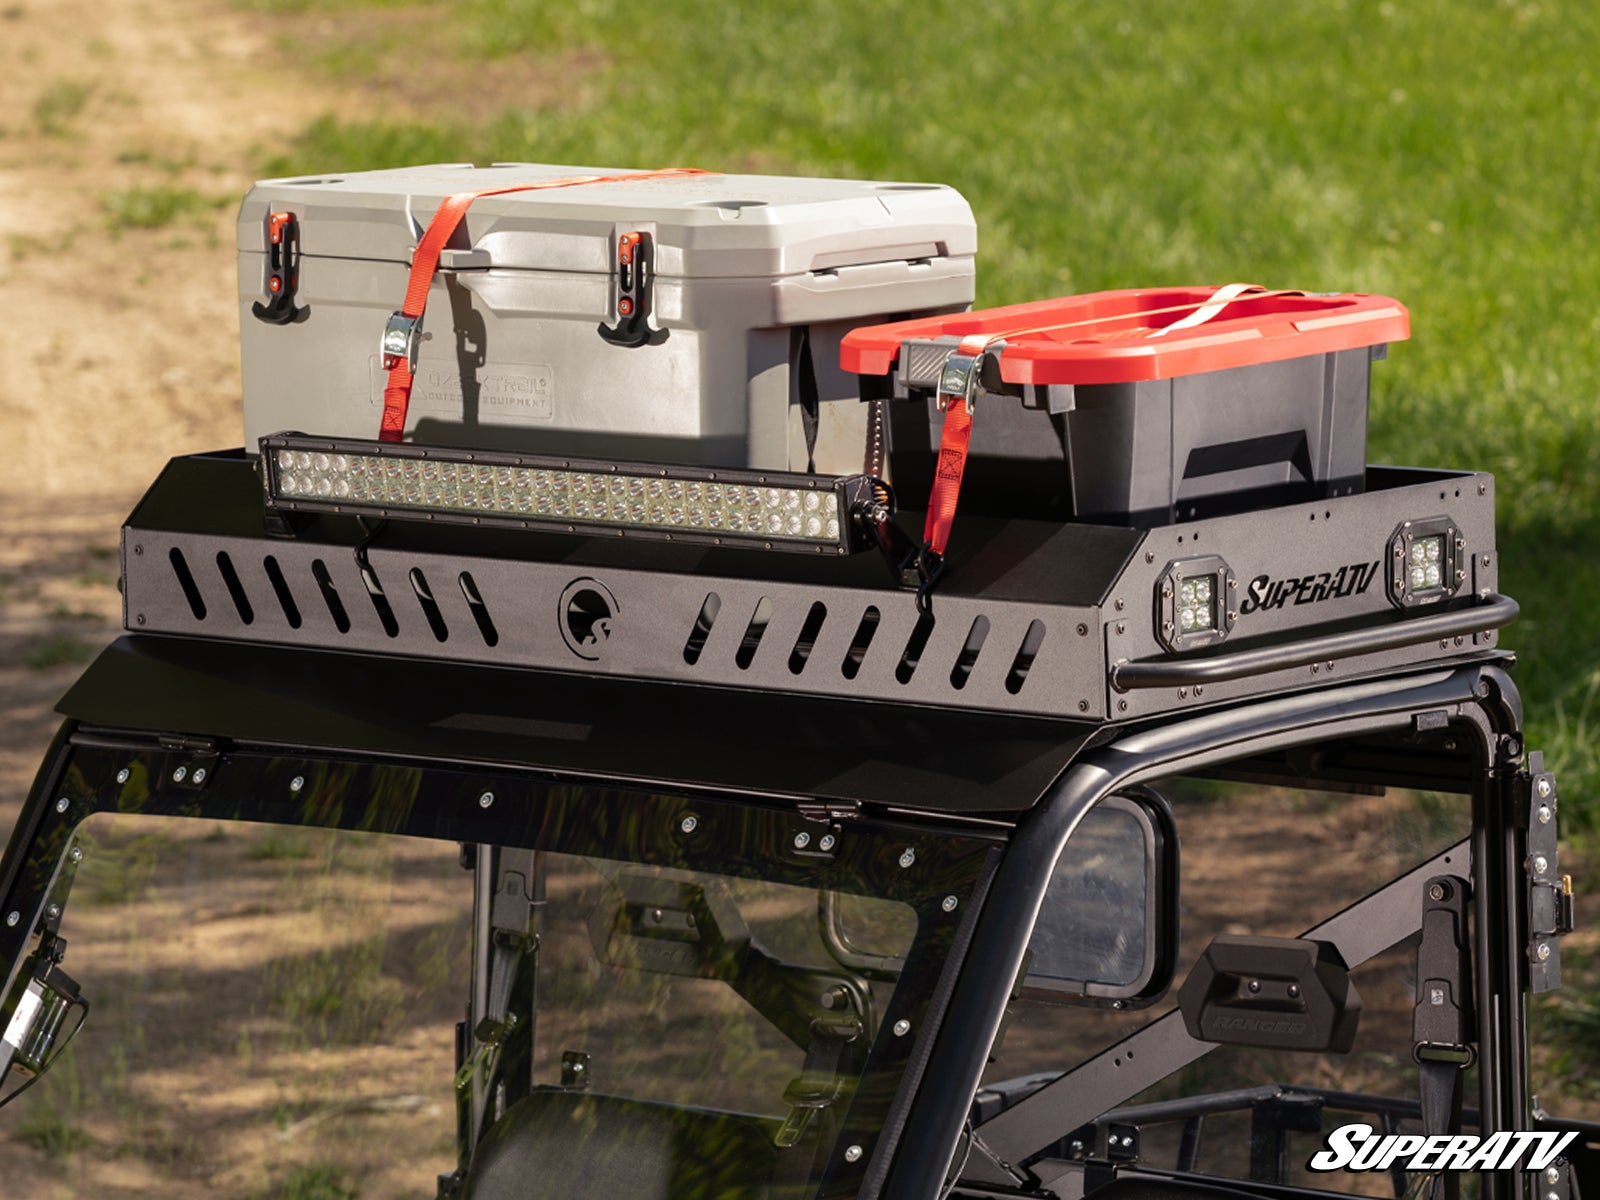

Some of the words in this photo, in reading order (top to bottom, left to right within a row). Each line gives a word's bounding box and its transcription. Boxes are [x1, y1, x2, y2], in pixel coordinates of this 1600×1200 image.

[482, 395, 546, 408] EQUIPMENT
[1239, 560, 1381, 615] SUPERATV
[1213, 1015, 1308, 1034] RANGER
